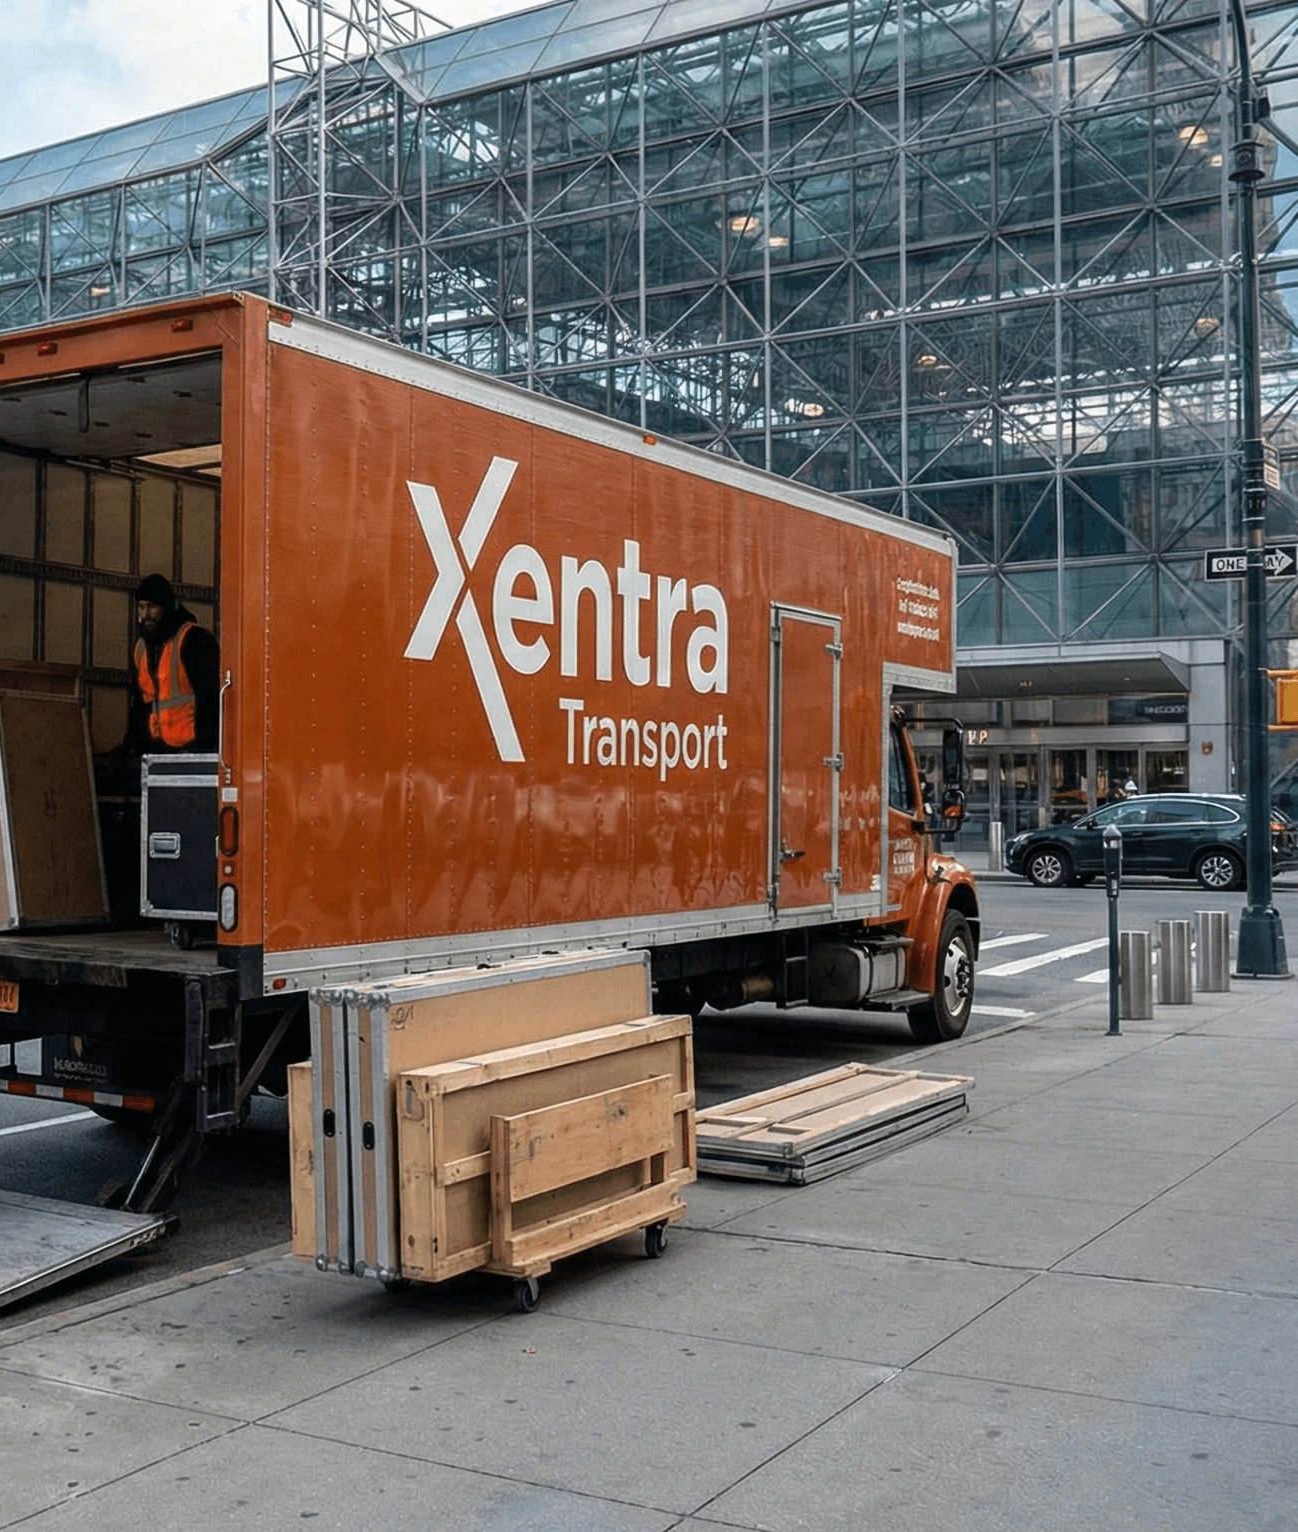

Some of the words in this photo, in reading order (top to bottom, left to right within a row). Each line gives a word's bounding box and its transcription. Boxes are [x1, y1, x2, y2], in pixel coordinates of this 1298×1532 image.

[1216, 558, 1245, 571] ONE
[404, 455, 729, 763] Xentra
[559, 698, 728, 782] Transport
